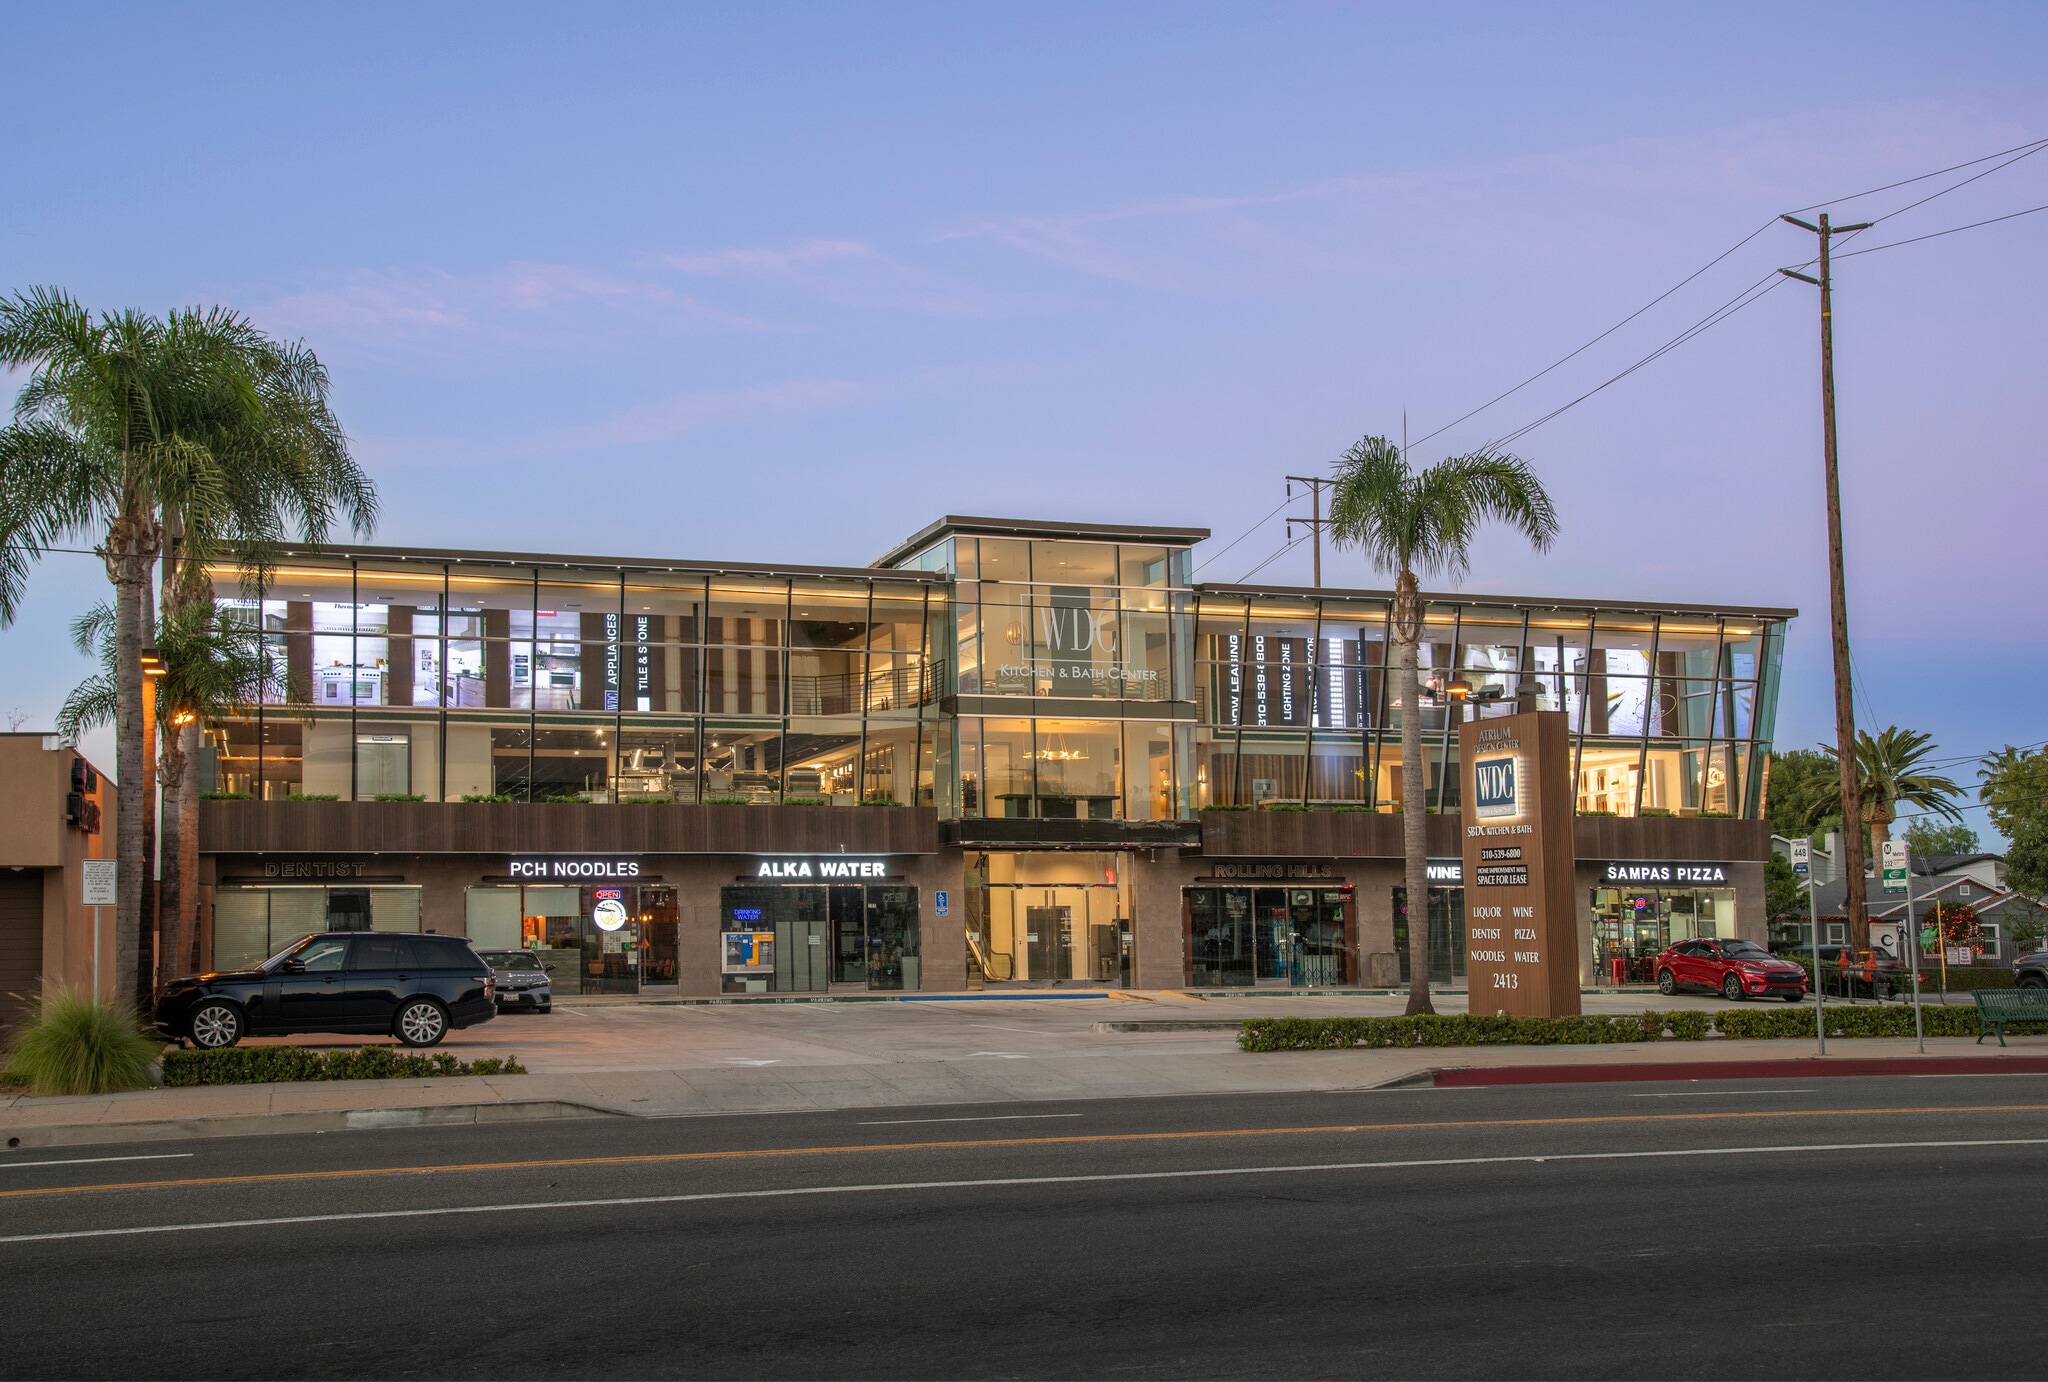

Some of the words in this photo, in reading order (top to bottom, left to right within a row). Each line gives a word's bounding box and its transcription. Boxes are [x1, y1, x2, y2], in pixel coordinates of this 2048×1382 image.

[638, 616, 648, 654] SONE
[1040, 607, 1117, 653] WDC
[607, 614, 617, 685] APPLIANCES
[638, 656, 648, 664] &
[1281, 643, 1291, 671] ZONE
[638, 667, 648, 690] TILE
[1059, 668, 1068, 678] &
[1282, 673, 1292, 720] LIGHTING
[1479, 726, 1511, 742] ATRIUM
[1474, 742, 1495, 753] DESIGN
[1496, 739, 1519, 751] CENTER
[1477, 763, 1513, 801] WDC
[1467, 825, 1486, 837] SBDC
[1487, 826, 1510, 836] KITCHEN
[1511, 826, 1516, 834] &
[1517, 824, 1532, 834] BATH
[1481, 848, 1521, 860] 310-539-6800
[265, 862, 365, 876] DENTIST
[510, 862, 547, 876] PCH
[554, 862, 639, 876] NOODLES
[758, 862, 812, 877] ALKA
[820, 862, 885, 877] WATER
[1214, 865, 1283, 877] ROLLING
[1287, 865, 1332, 877] HILLS
[1608, 867, 1670, 880] SAMPAS
[1677, 868, 1724, 881] PIZZA
[1477, 875, 1495, 885] SPACE
[1496, 875, 1509, 885] FOR
[1509, 874, 1527, 884] LEASE
[1473, 907, 1502, 919] LIQUOR
[1513, 907, 1534, 918] WINE
[1472, 928, 1501, 939] DENTIST
[1514, 929, 1536, 940] PIZZA
[1471, 951, 1505, 962] NOODLES
[1514, 952, 1539, 963] WATER
[1493, 973, 1518, 989] 2413
